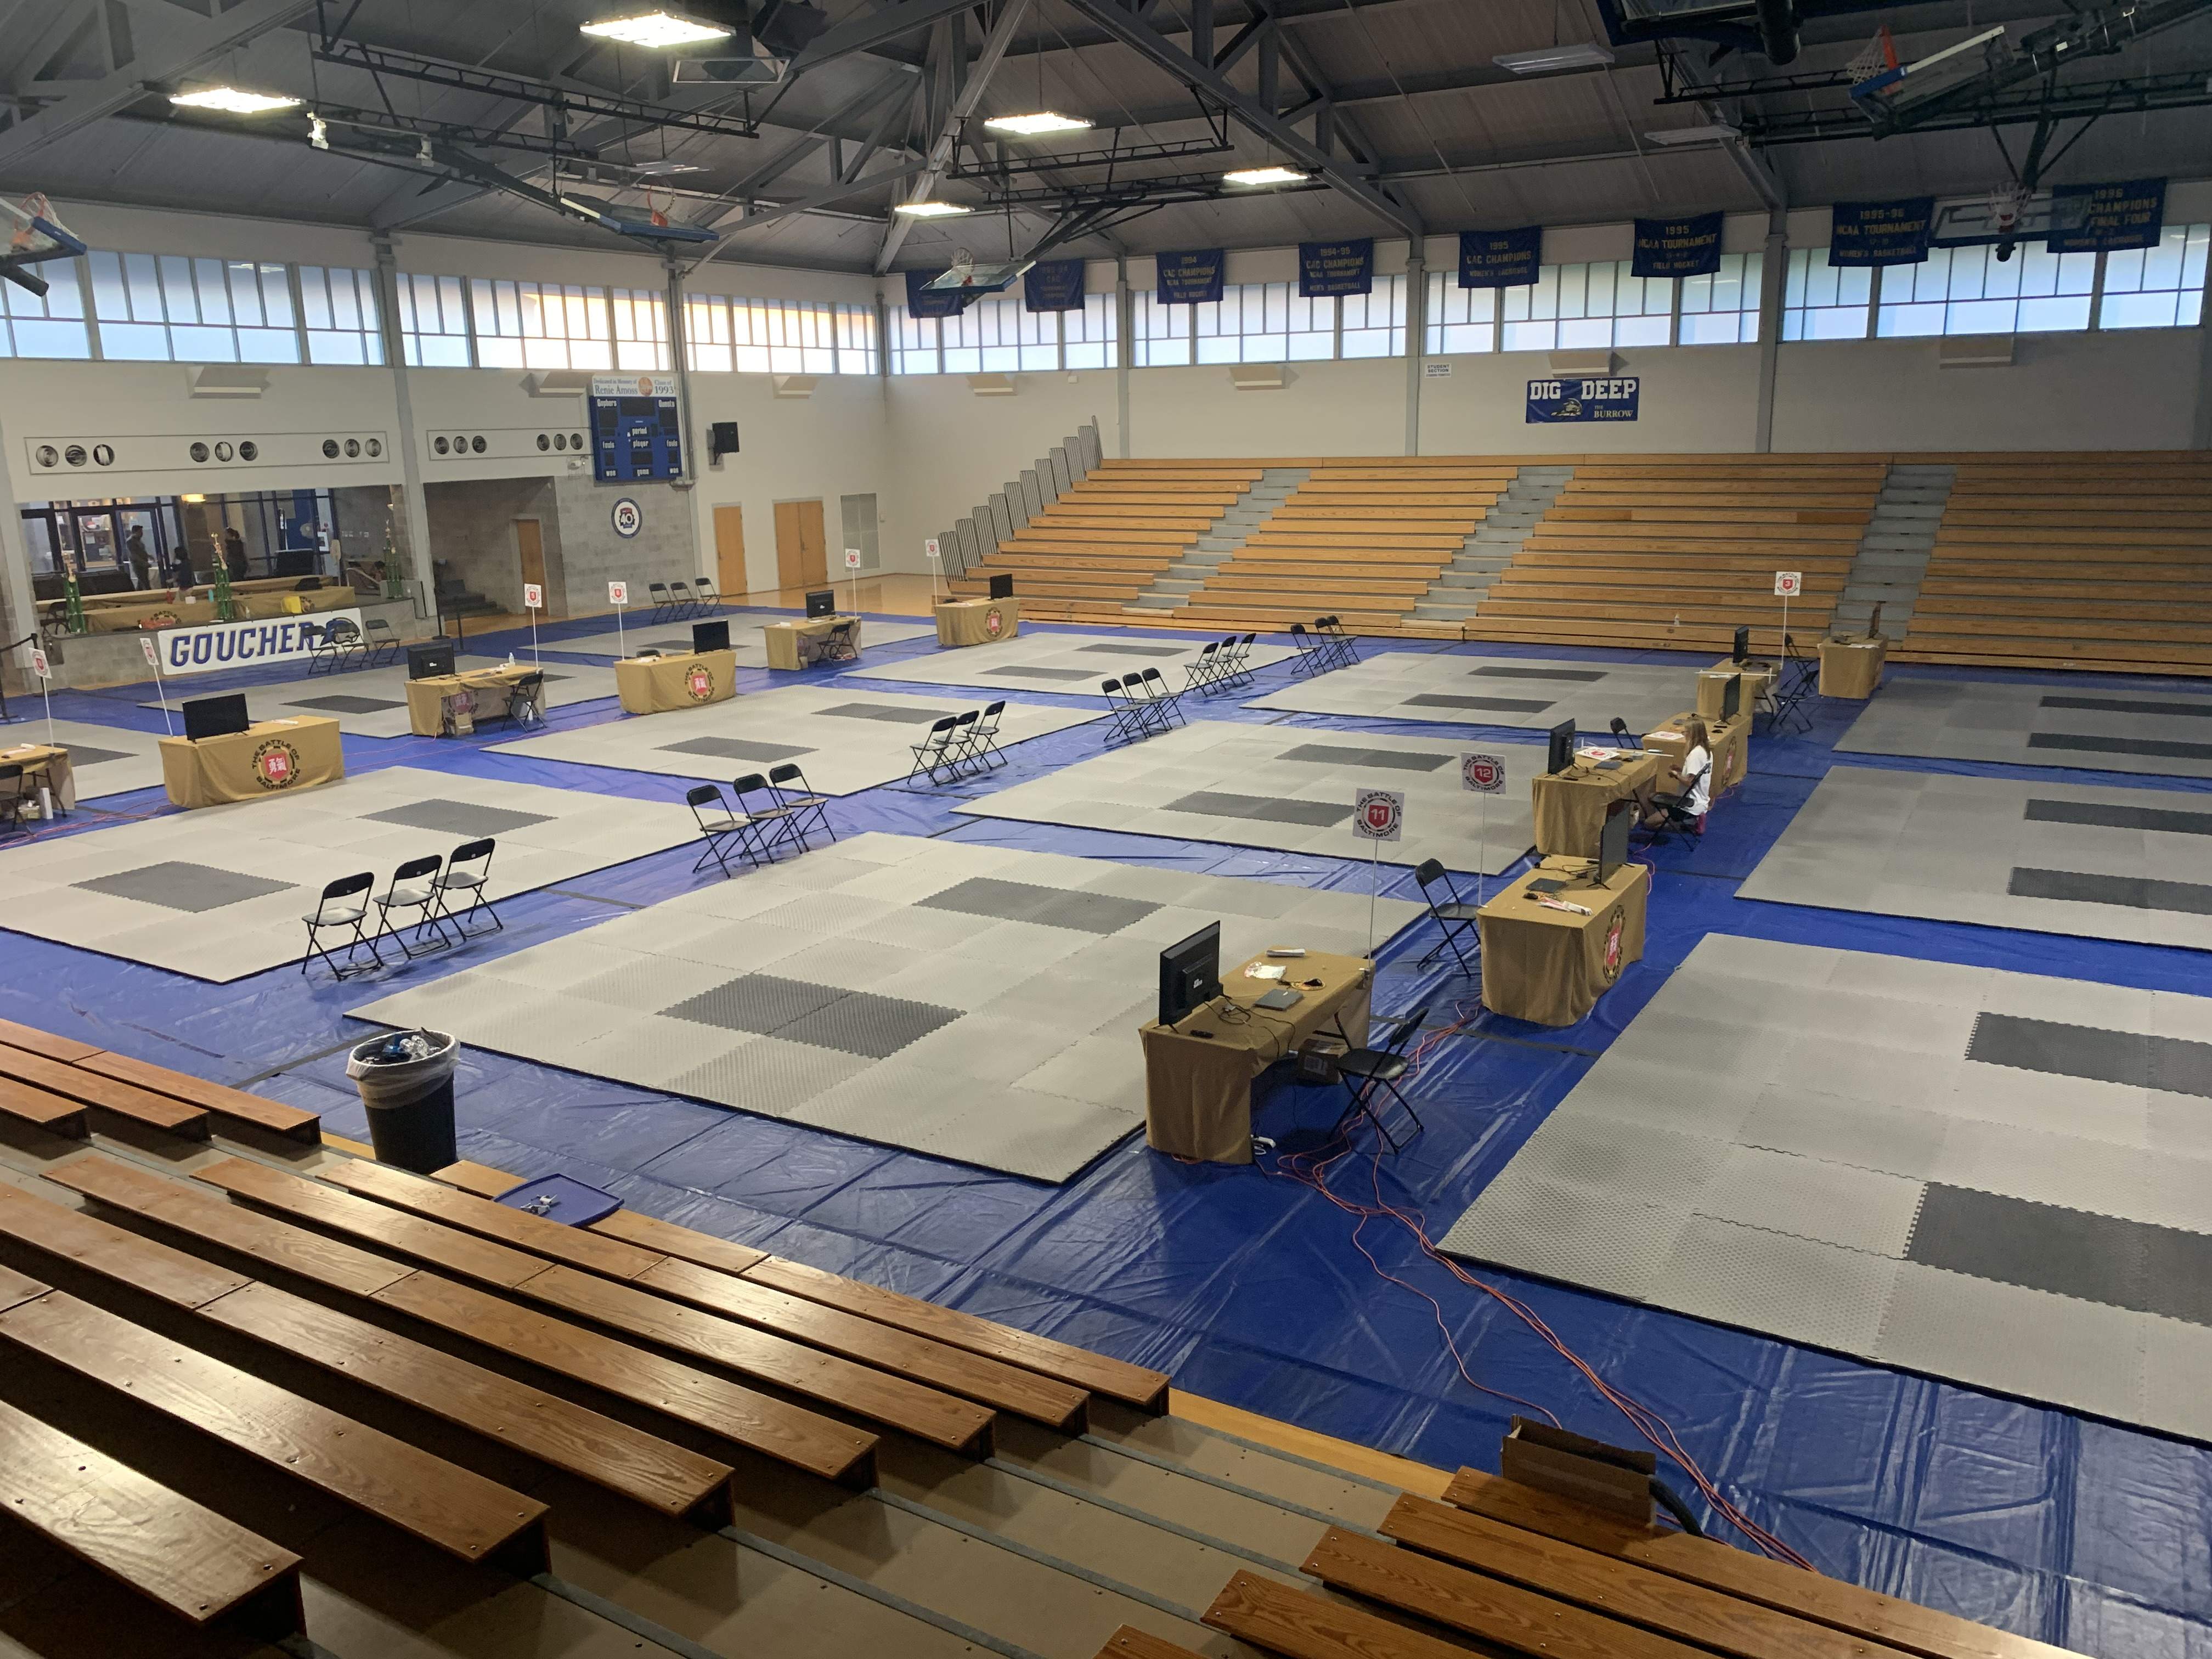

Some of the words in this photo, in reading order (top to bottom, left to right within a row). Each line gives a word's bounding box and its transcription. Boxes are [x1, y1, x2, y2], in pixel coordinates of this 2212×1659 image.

[1666, 225, 1690, 235] 1995
[1489, 241, 1509, 250] 1995
[1661, 233, 1717, 249] TOURNAMENT
[1323, 256, 1364, 269] CHAMPIONS
[1486, 250, 1531, 264] CHAMPIONS
[595, 384, 614, 394] Renie
[617, 385, 638, 394] Amoss
[655, 386, 674, 394] 1993
[1530, 381, 1561, 400] DIG
[1581, 379, 1637, 400] DEEP
[1594, 410, 1634, 419] BURROW
[620, 513, 634, 525] 40
[170, 621, 314, 667] GOUCHER
[252, 750, 261, 769] THE
[258, 739, 292, 751] BATTLE
[291, 748, 300, 760] OF
[1463, 759, 1472, 770] THE
[1471, 754, 1499, 765] BATTLE
[1498, 765, 1504, 775] OF
[256, 768, 301, 790] BALTIMORE
[1476, 768, 1492, 778] 12
[1465, 776, 1503, 791] BALTIMORE
[1356, 797, 1368, 812] THE
[1367, 791, 1397, 804] BATTLE
[1395, 805, 1401, 817] OF
[1370, 808, 1385, 821] 11
[1357, 819, 1399, 838] BALTIMORE
